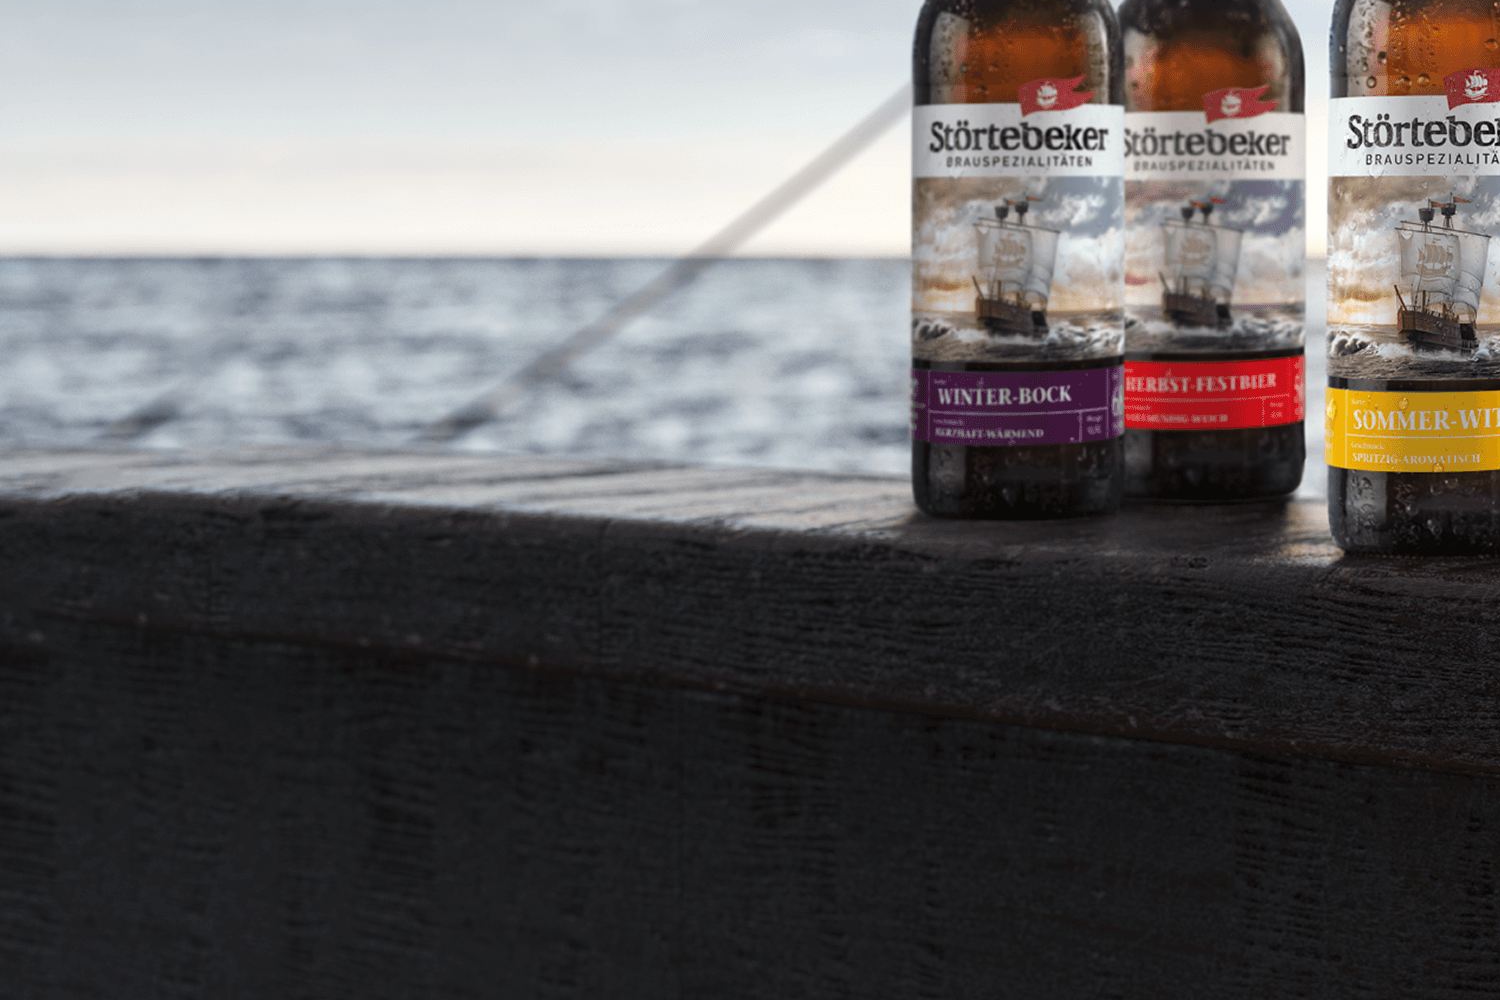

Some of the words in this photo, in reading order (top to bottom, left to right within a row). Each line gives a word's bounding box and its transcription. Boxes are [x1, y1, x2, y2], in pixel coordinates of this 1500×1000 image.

[929, 119, 1109, 153] Störtebeker
[1123, 126, 1292, 158] Störtebeker
[946, 153, 1093, 169] BRAUSPEZIALITÄTEN
[1133, 159, 1276, 172] BRAUSPEZIALITÄTEN
[937, 383, 1073, 407] WINTER-BOCK
